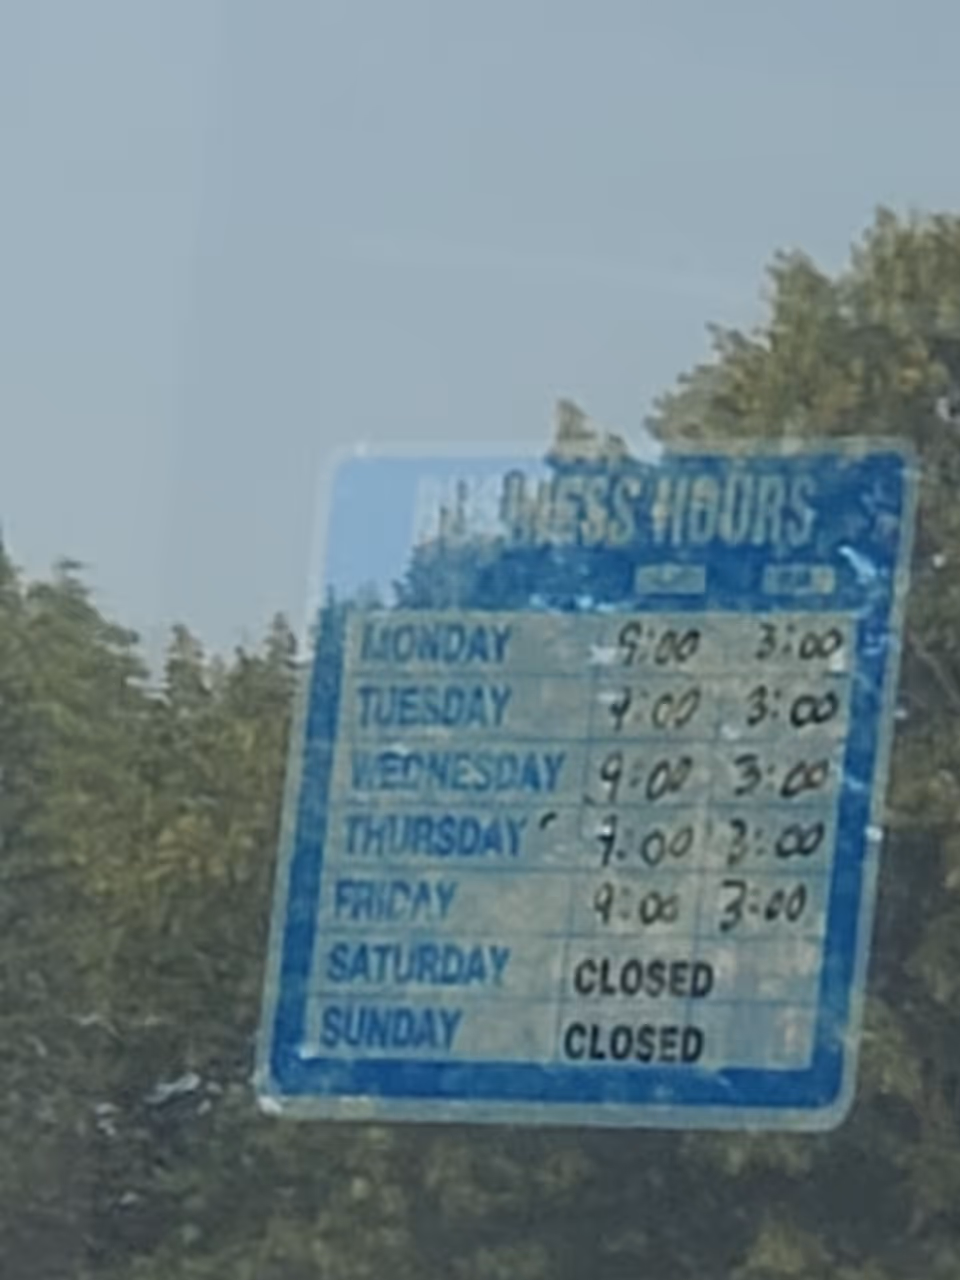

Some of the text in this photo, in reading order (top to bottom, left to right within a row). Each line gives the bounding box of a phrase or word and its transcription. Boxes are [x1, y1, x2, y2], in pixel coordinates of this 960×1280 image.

[649, 473, 817, 546] HOURS
[360, 622, 512, 663] MONDAY
[757, 622, 843, 660] 3:00
[356, 685, 512, 727] TUESDAY
[746, 684, 839, 728] 3:00
[351, 751, 829, 803] WEDNESDAY 9:00 3:00
[344, 815, 528, 858] THURSDAY
[333, 880, 457, 921] FRIDAY
[719, 878, 807, 932] 3:00
[325, 943, 715, 998] SATURDAY CLOSED
[319, 1005, 706, 1063] SUNDAY CLOSED
